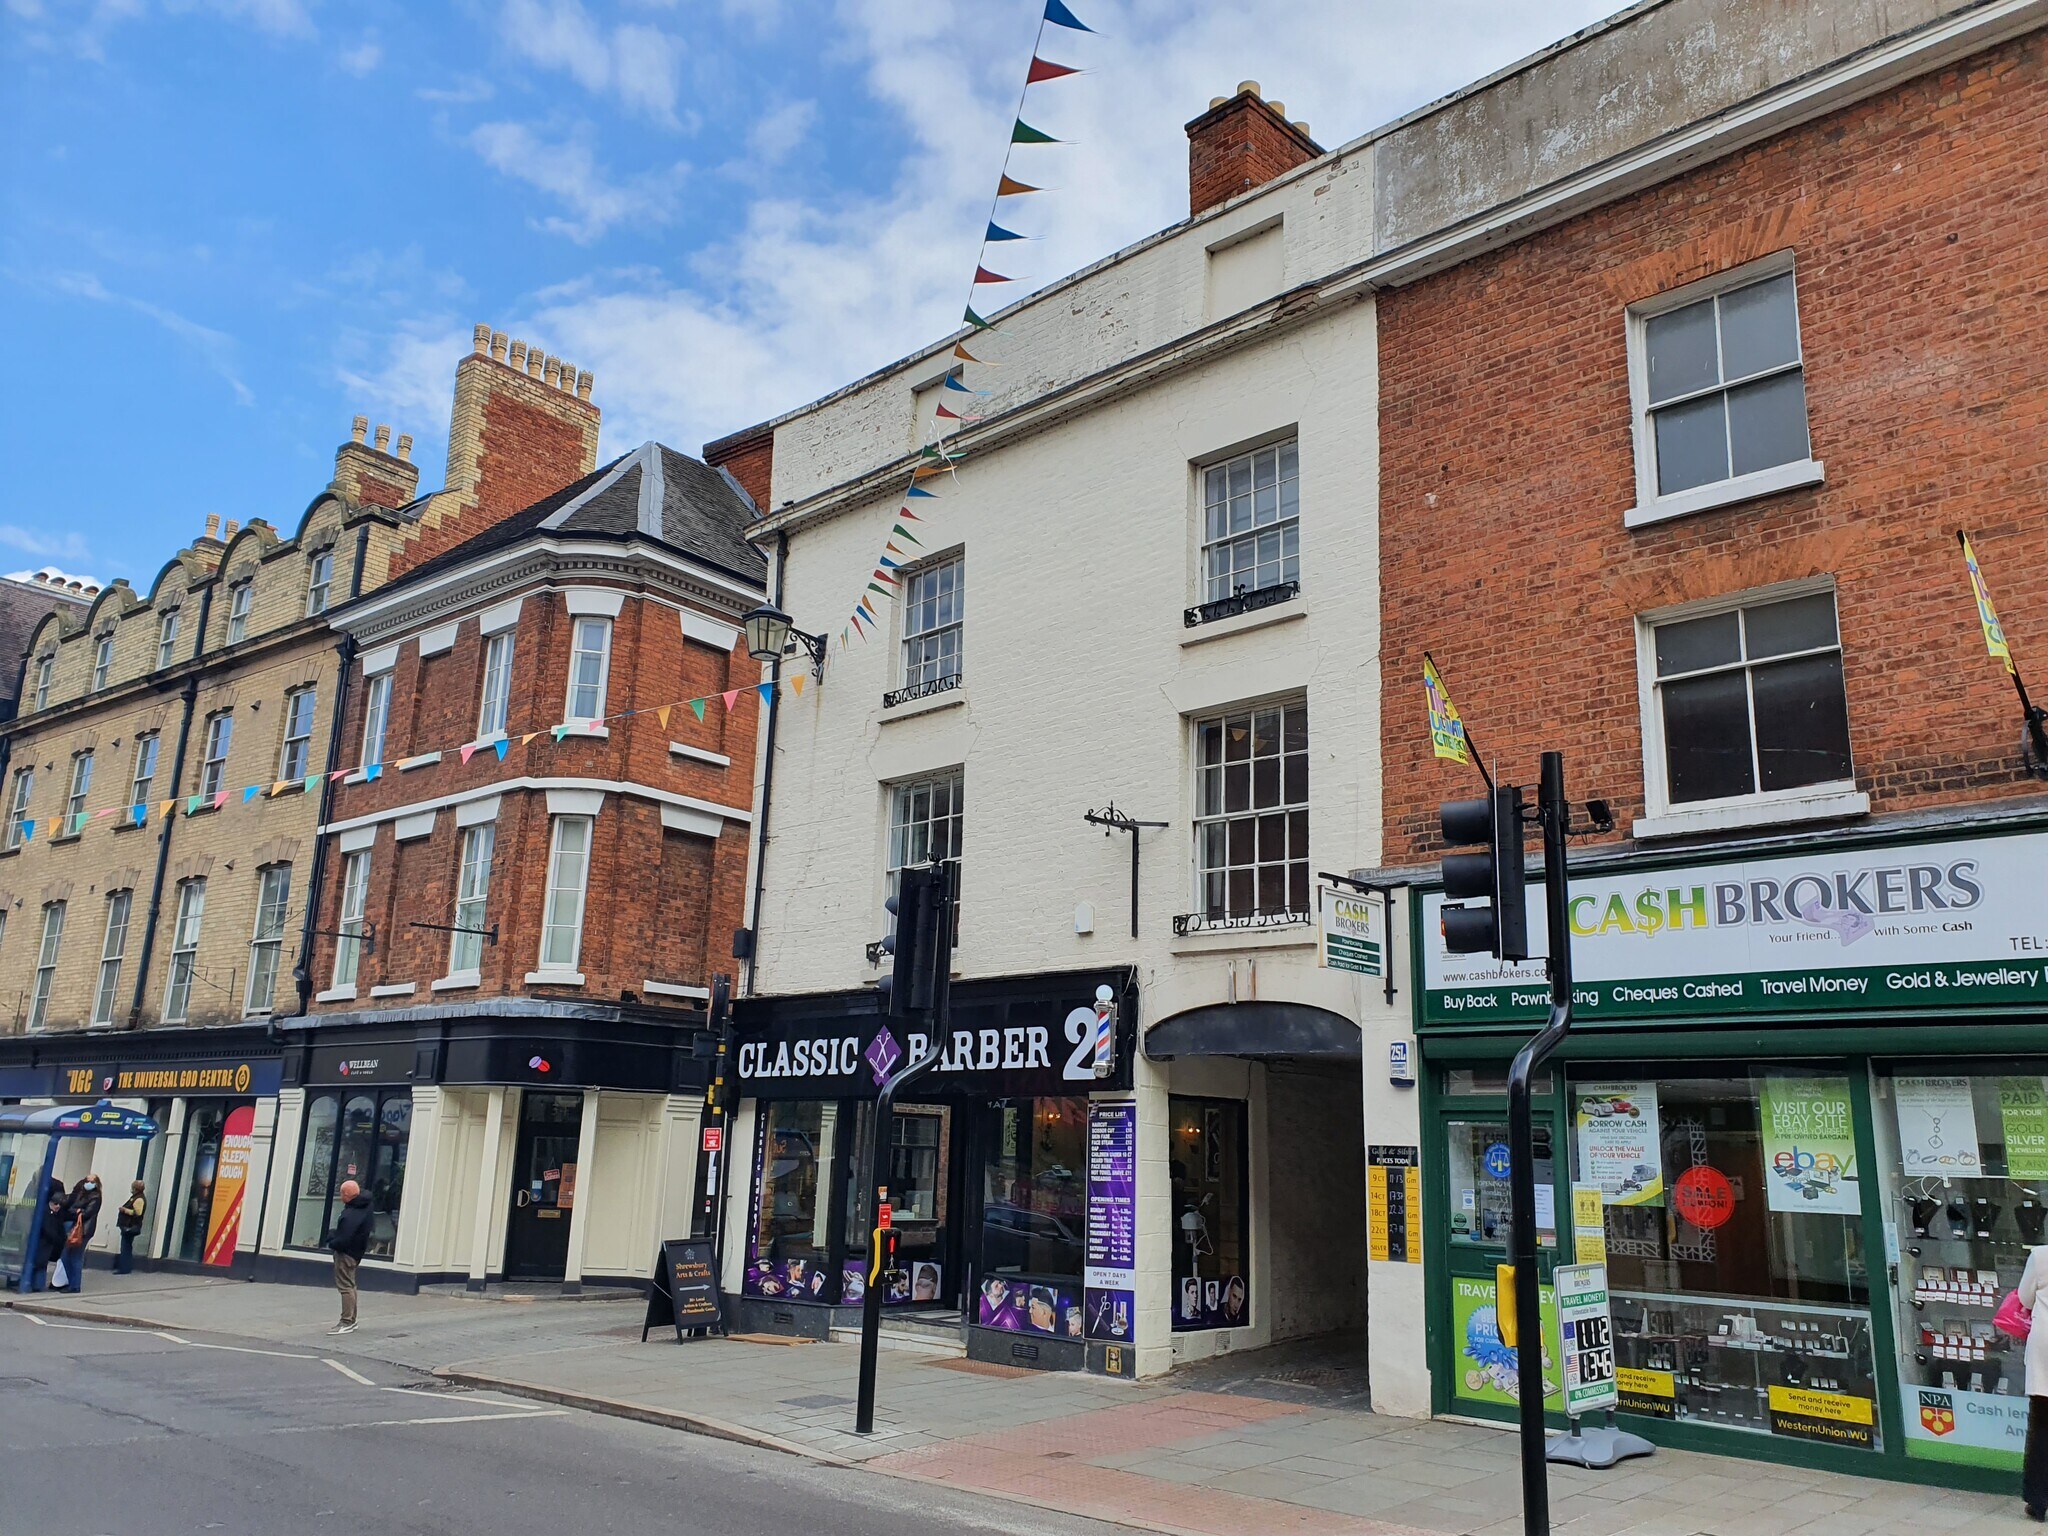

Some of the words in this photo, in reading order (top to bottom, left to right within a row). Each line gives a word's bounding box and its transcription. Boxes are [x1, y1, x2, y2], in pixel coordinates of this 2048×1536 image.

[1569, 886, 1708, 936] CA$H
[1716, 862, 1981, 926] BROKERS
[1335, 916, 1370, 934] BROKERS
[1769, 932, 1794, 944] Your
[1874, 925, 1901, 937] with
[1903, 923, 1939, 935] Some
[1942, 920, 1973, 933] Cash
[2009, 936, 2048, 951] TEL:
[1443, 968, 1547, 982] www.cashbrokers.co
[1444, 995, 1465, 1011] Buy
[1467, 993, 1498, 1008] Back
[1612, 983, 1678, 1003] Cheques
[1683, 980, 1743, 999] Cashed
[1760, 975, 1808, 995] Travel
[1810, 976, 1868, 995] Money
[1886, 972, 1931, 990] Gold
[1935, 971, 1949, 988] &
[1951, 967, 2039, 988] Jewellery
[738, 1036, 860, 1079] CLASSIC
[1063, 1006, 1096, 1081] 2
[349, 1059, 379, 1069] WELLBEAN
[69, 1068, 93, 1093] UGC
[118, 1072, 132, 1089] THE
[134, 1070, 178, 1089] UNIVERSAL
[180, 1070, 198, 1088] GOD
[199, 1069, 233, 1087] CENTRE
[2001, 1092, 2040, 1105] PAID
[1772, 1102, 1808, 1114] VISIT
[1812, 1102, 1846, 1114] OUR
[1588, 1120, 1622, 1128] BORROW
[1625, 1120, 1648, 1128] CASH
[1773, 1115, 1810, 1128] EBAY
[1815, 1114, 1847, 1128] SITE
[1810, 1127, 1848, 1135] YOURSELF
[2005, 1124, 2044, 1133] GOLD
[2006, 1135, 2045, 1145] SILVER
[1774, 1145, 1854, 1178] ebay
[219, 1165, 244, 1178] ROUGH
[1406, 1194, 1417, 1202] Gm
[1371, 1208, 1385, 1217] 18CT
[1407, 1211, 1418, 1219] Gm
[1371, 1226, 1385, 1235] 22CT
[1408, 1230, 1419, 1238] Gm
[1408, 1246, 1419, 1254] Gm
[675, 1262, 707, 1270] Shrewsbury
[694, 1270, 711, 1278] Crafts
[1458, 1283, 1496, 1298] TRAVE
[1562, 1295, 1582, 1306] TRAVEL
[1475, 1324, 1498, 1336] PRIC
[1633, 1375, 1656, 1383] receive
[1582, 1384, 1609, 1397] COMMISSION
[1788, 1393, 1806, 1402] Send
[1824, 1399, 1851, 1408] receive
[1920, 1393, 1951, 1406] NPA
[1798, 1403, 1823, 1413] money
[1825, 1407, 1842, 1415] here
[1967, 1402, 2002, 1417] Cash
[2008, 1406, 2030, 1419] len
[1777, 1418, 1847, 1438] WesternUnion
[2005, 1425, 2028, 1437] An
